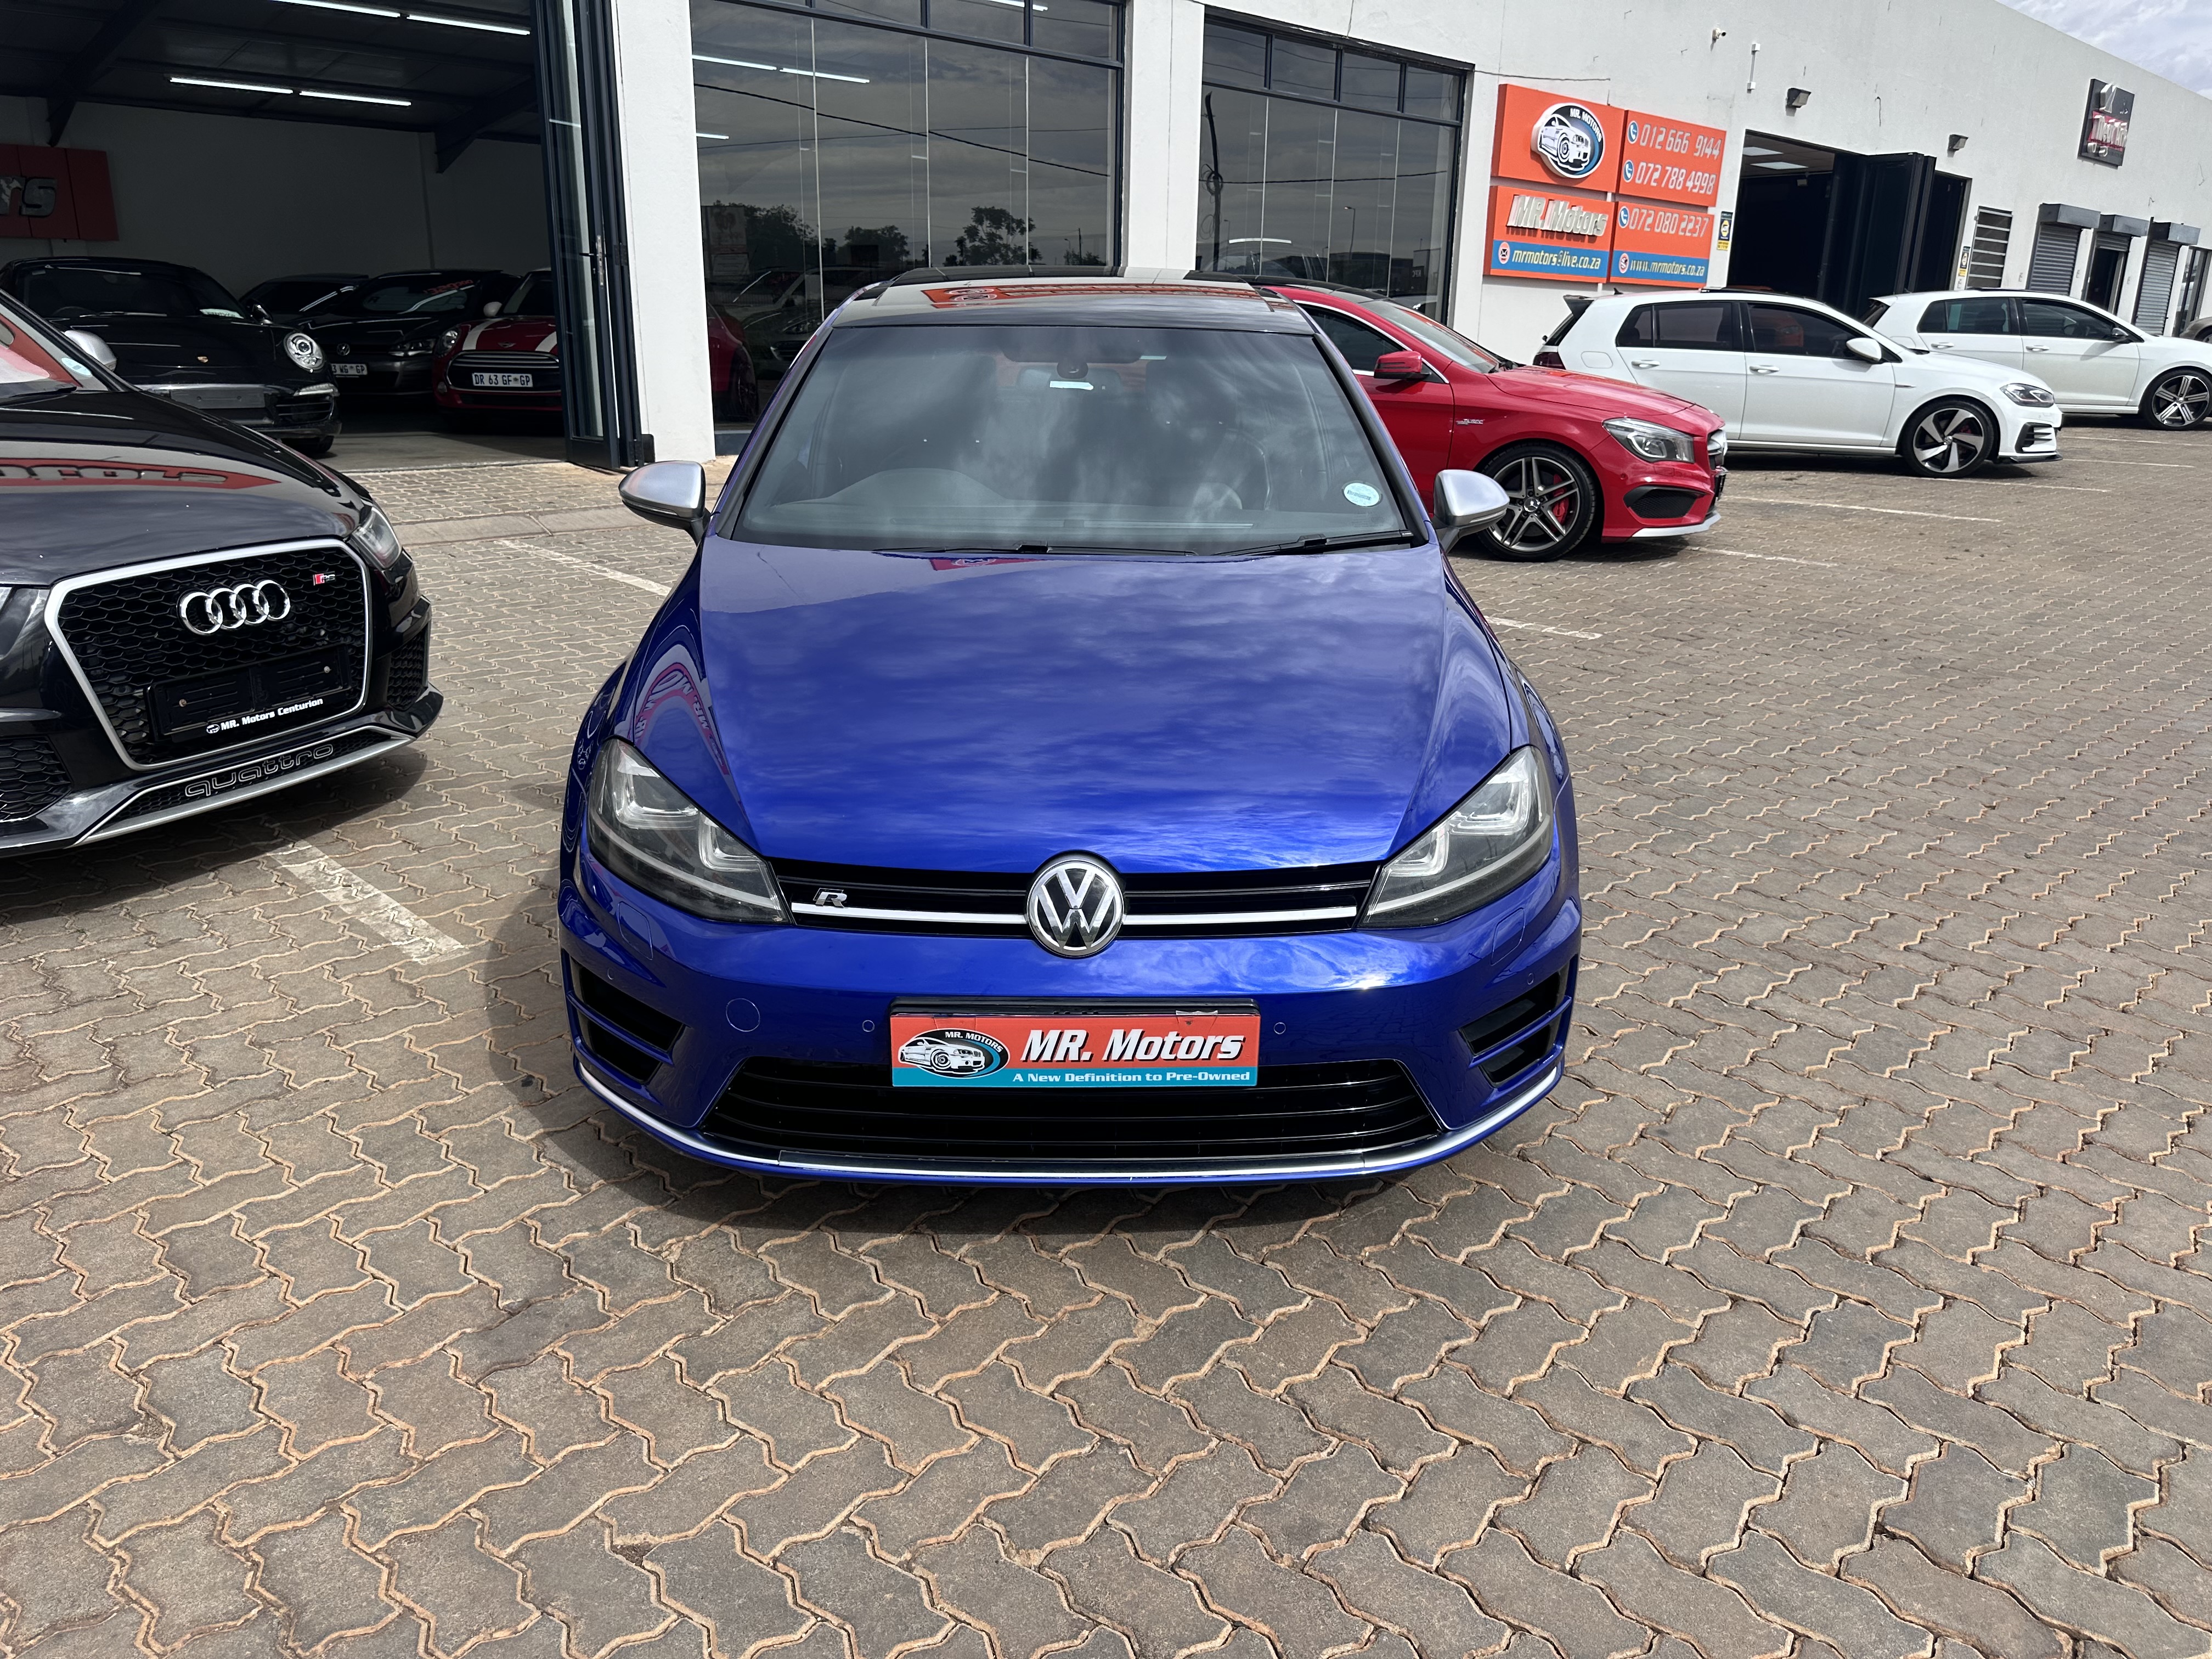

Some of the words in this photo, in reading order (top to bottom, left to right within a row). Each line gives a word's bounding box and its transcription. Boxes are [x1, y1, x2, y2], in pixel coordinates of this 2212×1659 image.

[1570, 108, 1581, 119] MR.
[1581, 111, 1602, 143] MOTORS
[1639, 124, 1666, 149] 012
[1666, 129, 1691, 154] 666
[1694, 135, 1722, 160] 9144
[1635, 162, 1662, 187] 072
[1661, 166, 1686, 190] 788
[1686, 171, 1717, 195] 4998
[1542, 200, 1609, 237] Motors
[1628, 208, 1655, 231] 072
[1654, 211, 1679, 234] 080
[1678, 215, 1709, 238] 2237
[1511, 250, 1601, 269] mrmotors@live.co.za
[474, 374, 485, 385] DR
[488, 374, 499, 385] 63
[502, 375, 512, 385] GF
[520, 375, 530, 386] GP
[221, 719, 240, 730] MR.
[241, 710, 275, 725] Motors
[278, 698, 324, 715] Centurion
[185, 743, 334, 797] quattro
[814, 889, 848, 909] R
[966, 1032, 1003, 1053] MOTORS
[1020, 1029, 1094, 1062] MR.
[1101, 1028, 1246, 1062] Motors
[1012, 1073, 1024, 1082] A
[1028, 1073, 1061, 1082] New
[1065, 1073, 1142, 1082] Definition
[1146, 1073, 1162, 1081] to
[1166, 1071, 1250, 1081] Pre-Owned
